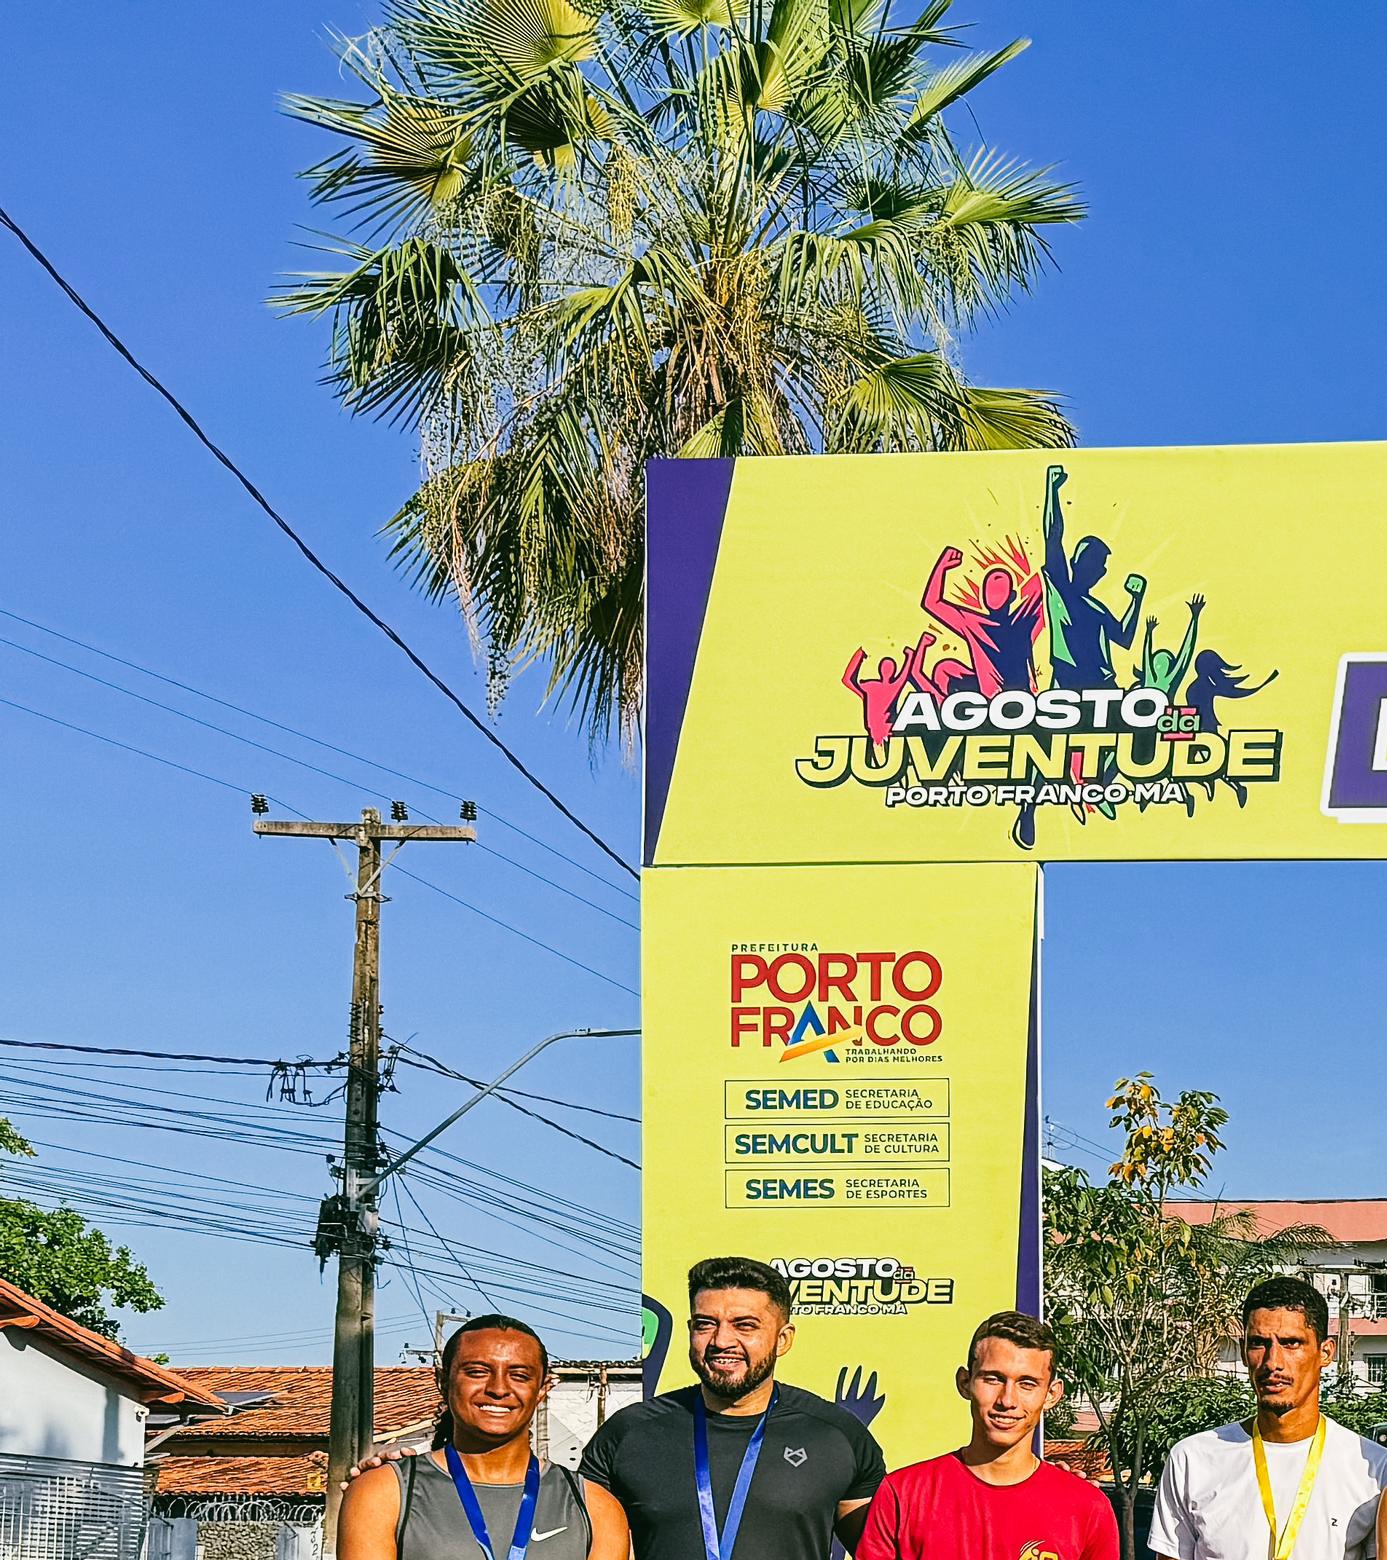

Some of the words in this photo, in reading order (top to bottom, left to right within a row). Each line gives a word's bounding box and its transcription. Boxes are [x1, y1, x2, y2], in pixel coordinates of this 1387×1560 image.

[892, 688, 1167, 732] AGOSTO
[1156, 707, 1200, 734] da
[796, 730, 1281, 785] JUVENTUDE
[886, 785, 989, 806] PORTO
[731, 943, 819, 952] PREFEITURA
[731, 951, 942, 1003] PORTO
[731, 1002, 942, 1055] FRANCO
[845, 1048, 917, 1056] TRABALHANDO
[845, 1056, 866, 1064] POR
[868, 1055, 890, 1064] DIAS
[892, 1055, 943, 1063] MELHORES
[745, 1089, 839, 1110] SEMED
[845, 1089, 920, 1098] SECRETARIA
[845, 1100, 862, 1109] DE
[865, 1097, 933, 1111] EDUCAÇÃO
[735, 1133, 859, 1154] SEMCULT
[864, 1133, 938, 1143] SECRETARIA
[864, 1144, 880, 1154] DE
[884, 1144, 939, 1154] CULTURA
[745, 1179, 835, 1199] SEMES
[845, 1178, 920, 1188] SECRETARIA
[846, 1189, 862, 1199] DE
[865, 1189, 928, 1199] ESPORTES
[768, 1257, 901, 1279] AGOSTO
[815, 1304, 880, 1314] FRANCO
[881, 1303, 907, 1314] MA
